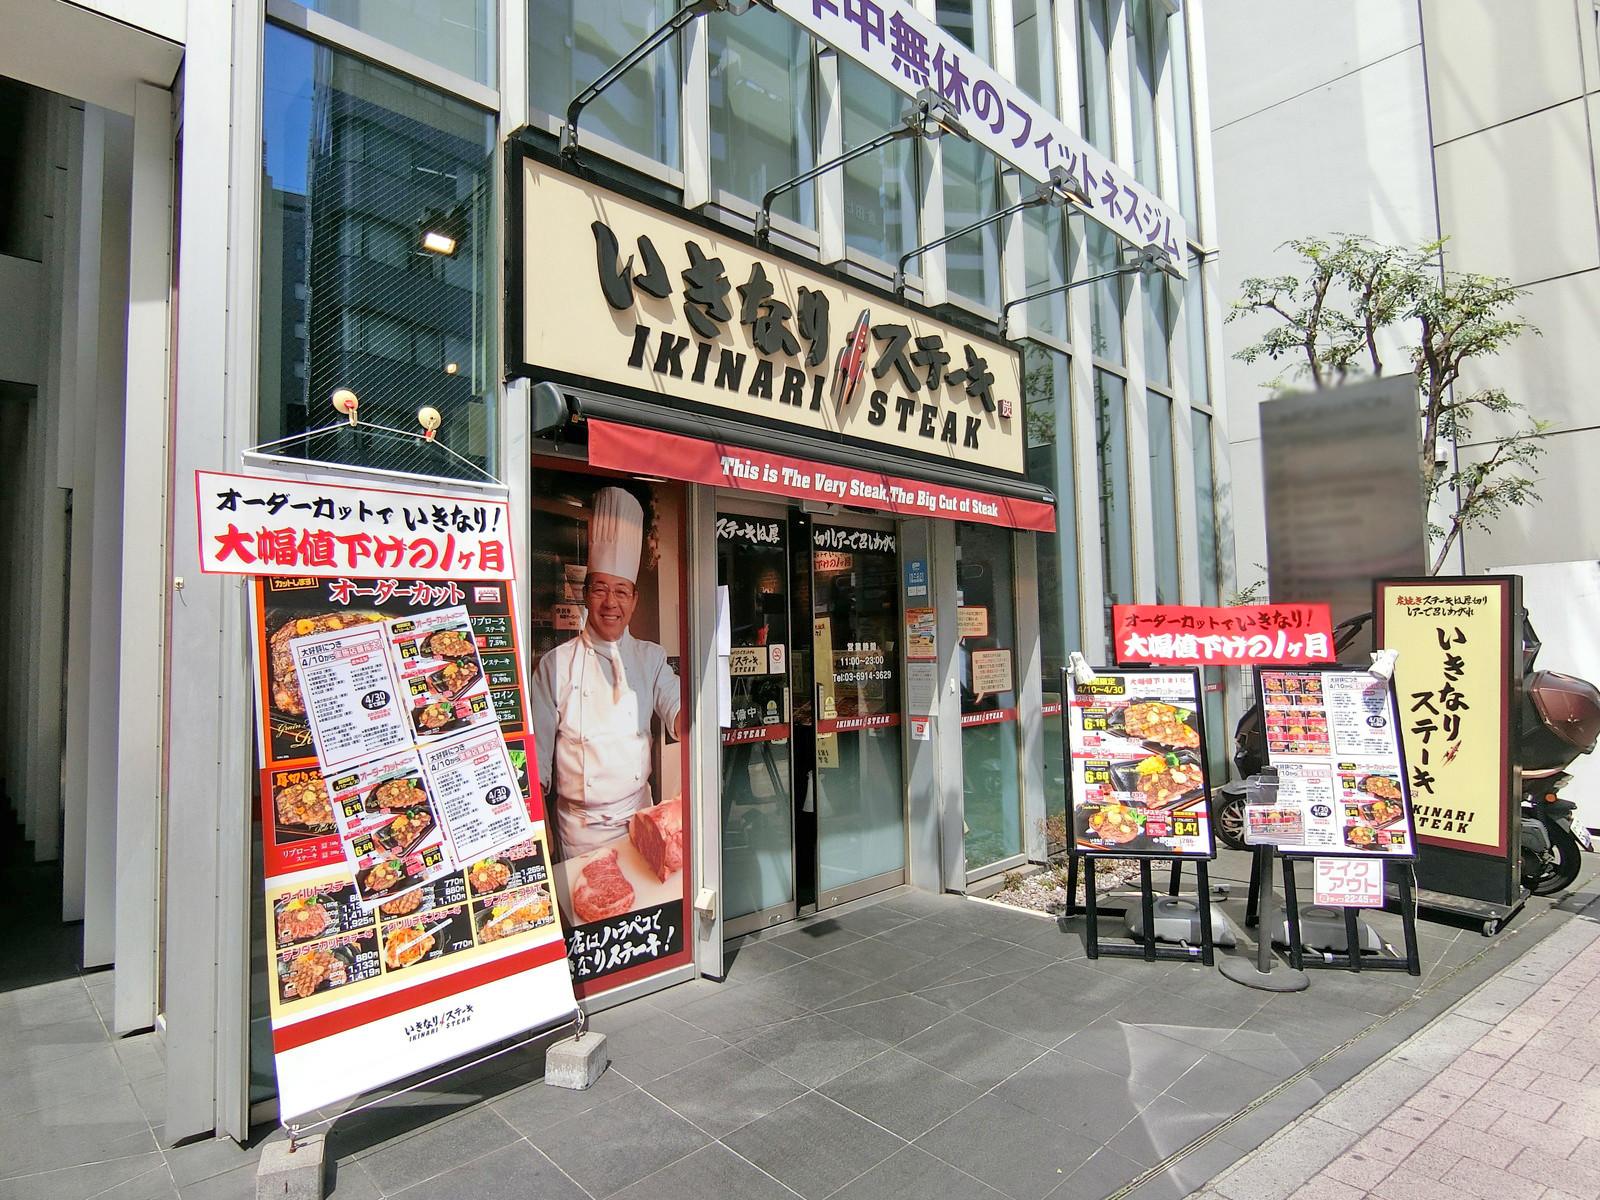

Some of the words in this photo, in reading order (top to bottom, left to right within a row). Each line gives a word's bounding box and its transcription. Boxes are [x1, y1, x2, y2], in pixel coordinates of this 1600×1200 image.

[591, 220, 829, 367] いきなり
[871, 323, 996, 412] ステーキ
[627, 325, 825, 412] IKINARI
[867, 390, 981, 449] STEAK
[720, 456, 760, 481] This
[762, 464, 779, 483] is
[781, 467, 811, 489] The
[814, 473, 847, 498] Very
[916, 490, 937, 511] Big
[939, 494, 957, 511] Cut
[959, 498, 970, 513] of
[971, 498, 999, 517] Steak
[329, 578, 465, 606] オーダーカット
[1396, 595, 1488, 606] 炭焼きステーキは厚切り
[1436, 626, 1470, 742] いきなり
[737, 728, 767, 740] STEAK
[836, 719, 863, 729] IKINARI
[867, 715, 890, 725] STEAK
[1410, 691, 1440, 795] ステーキ
[283, 846, 317, 858] リブロース
[1319, 861, 1369, 877] テイク
[1329, 877, 1378, 893] アウト
[405, 1015, 438, 1036] いきなり
[446, 1004, 474, 1021] ステーキ
[409, 1027, 438, 1042] IKINARI
[446, 1016, 471, 1029] STEAK
